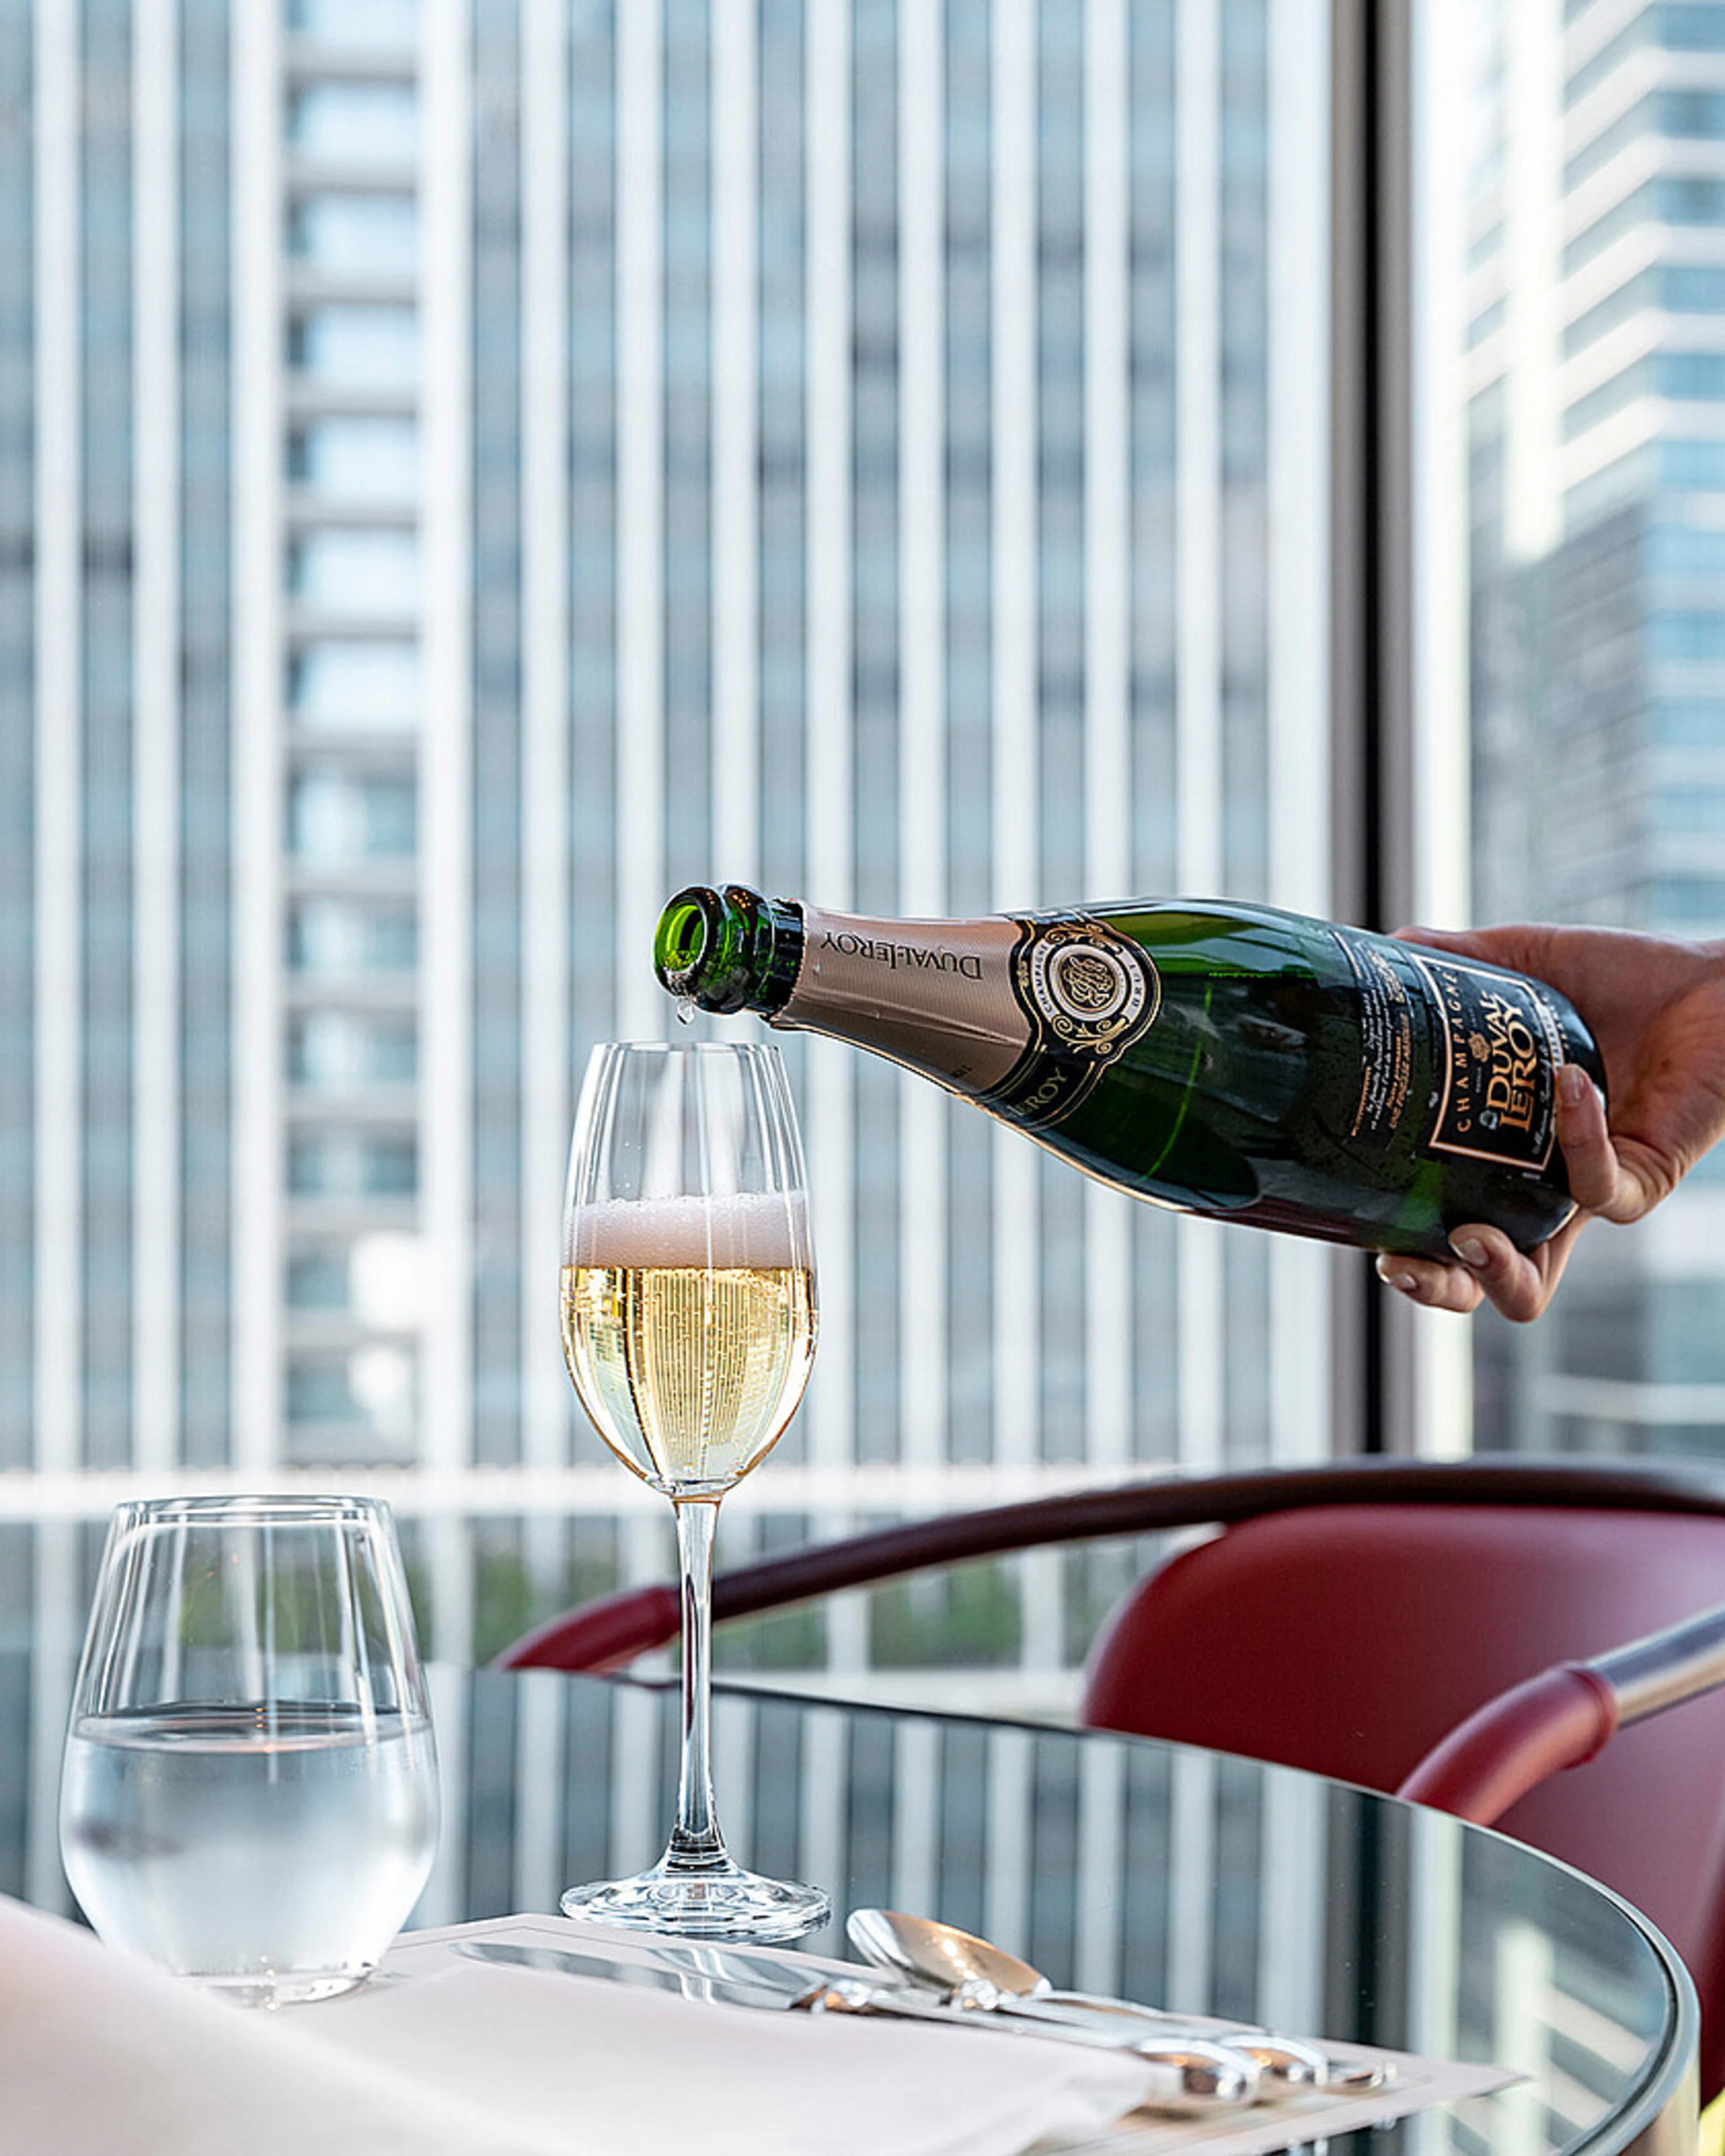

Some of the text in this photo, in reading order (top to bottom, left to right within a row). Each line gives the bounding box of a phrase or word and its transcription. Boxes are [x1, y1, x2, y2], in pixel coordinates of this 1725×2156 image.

[821, 931, 983, 980] DUVAL-LEROY
[1443, 972, 1472, 1132] CHAMPAGNE
[1491, 993, 1538, 1133] LEROY
